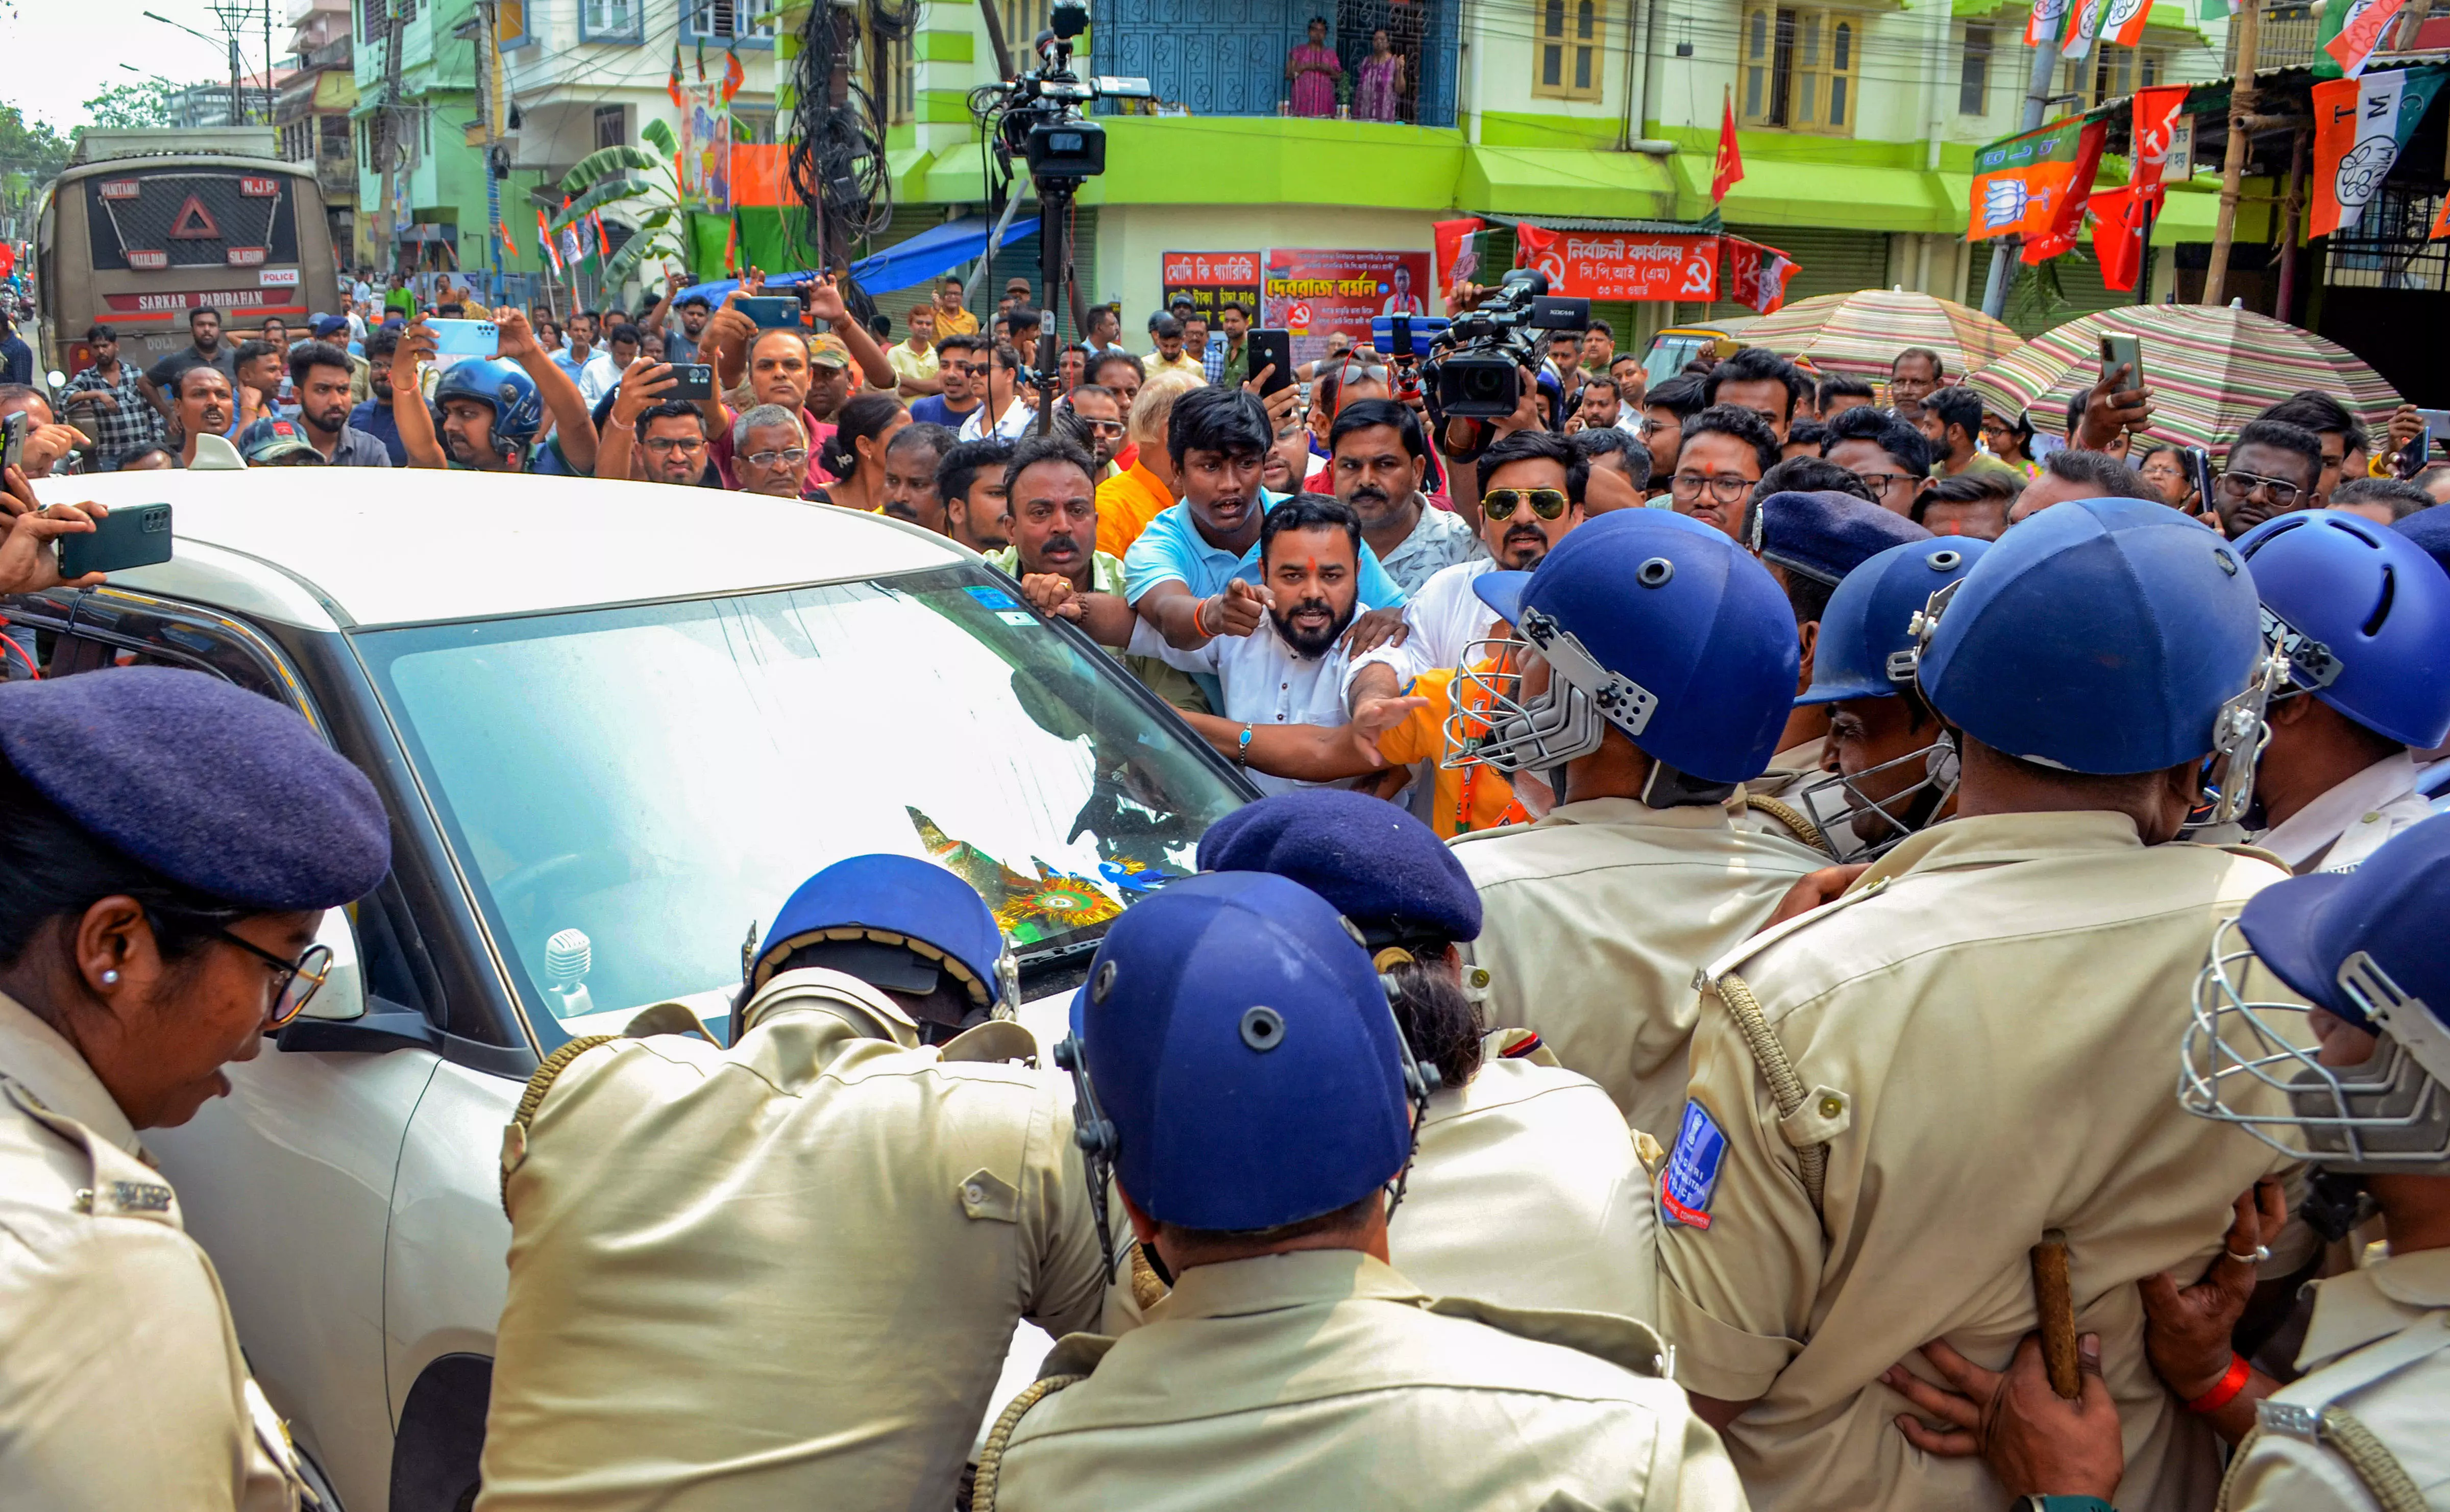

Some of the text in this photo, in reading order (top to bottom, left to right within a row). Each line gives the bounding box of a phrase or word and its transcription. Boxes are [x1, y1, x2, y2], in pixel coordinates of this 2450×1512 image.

[1567, 238, 1683, 265] নির্বাচনী কার্যালয়
[1167, 257, 1193, 281] মোদি
[1196, 257, 1210, 281] কি
[1641, 267, 1671, 283] (এম)
[1266, 277, 1336, 299] দেবরাজ
[1337, 270, 1378, 298] বর্মন
[139, 291, 263, 310] SARKAR PARIBAHAN
